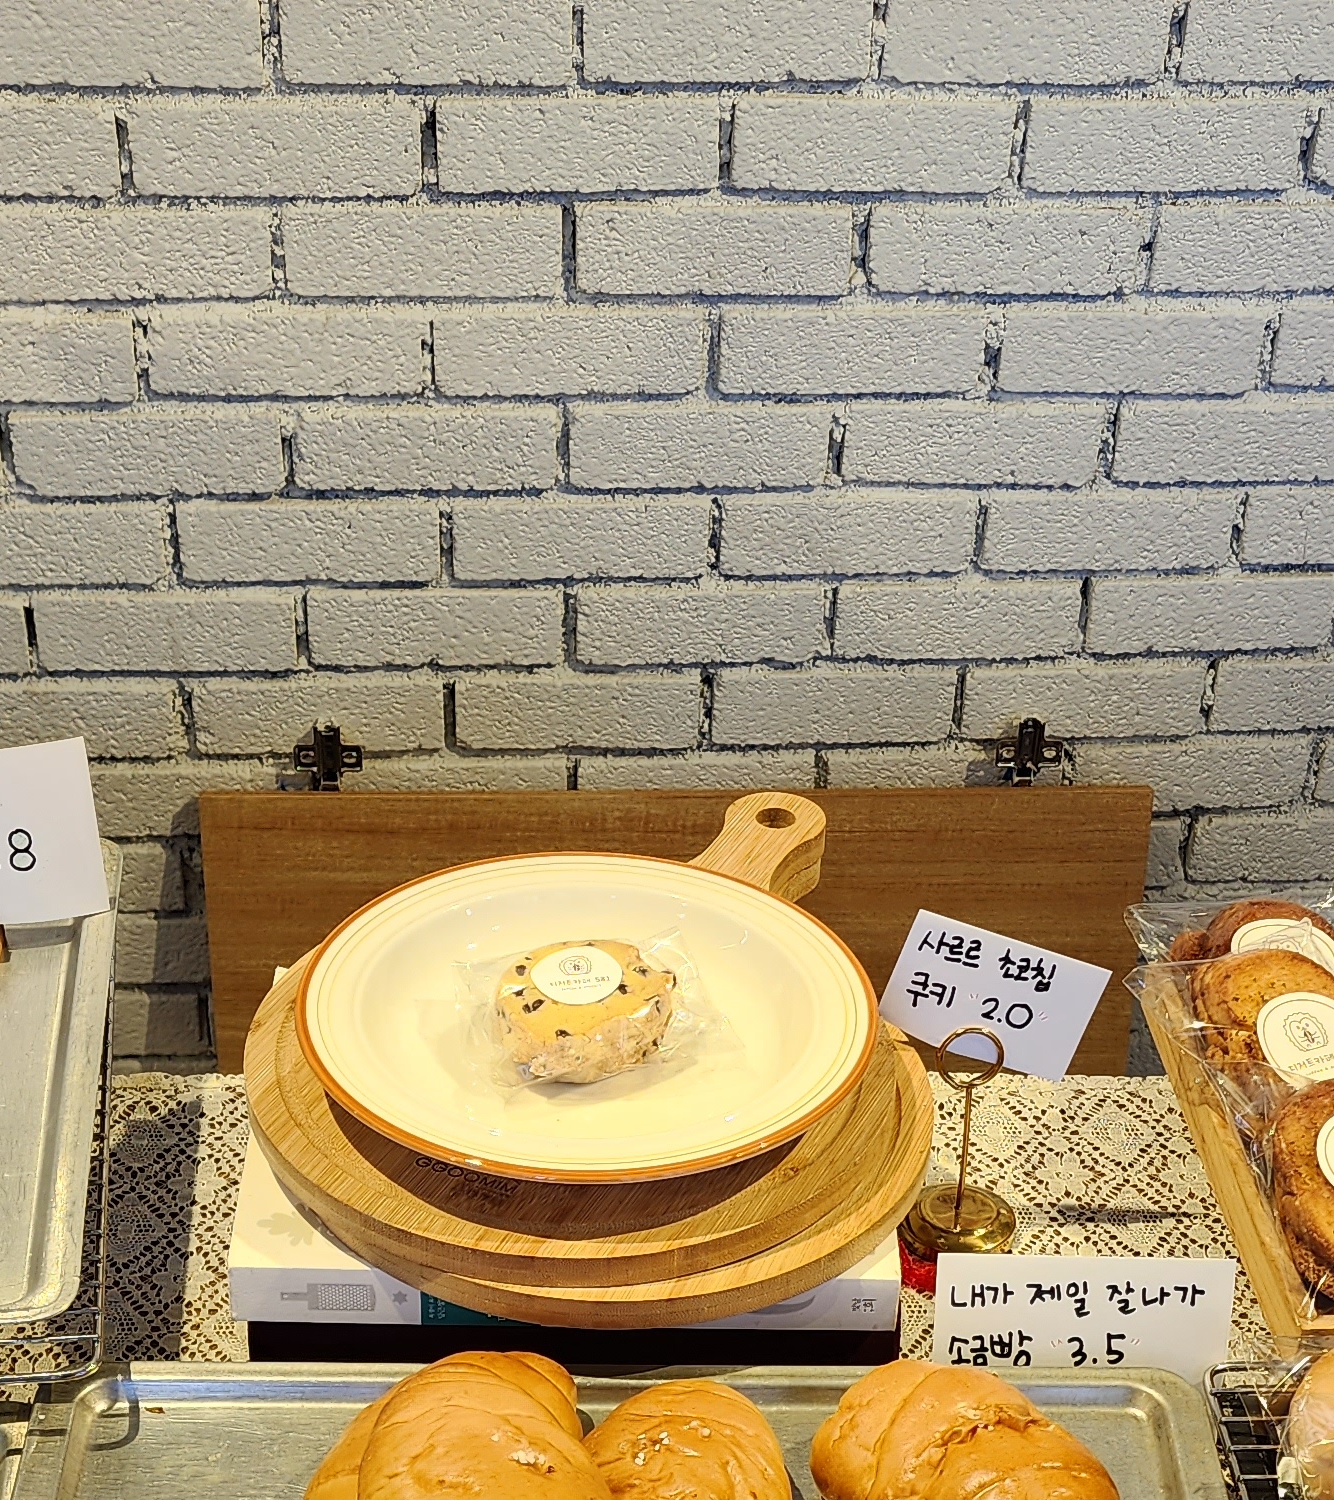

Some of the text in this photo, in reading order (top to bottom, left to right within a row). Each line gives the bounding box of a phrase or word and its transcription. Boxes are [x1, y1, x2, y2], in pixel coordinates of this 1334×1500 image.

[917, 930, 1057, 993] 사르르 초코칩
[905, 971, 957, 1007] 쿠키
[949, 1280, 1206, 1318] 내가 제일 잘나가
[948, 1329, 1128, 1367] 소금빵 3.5
